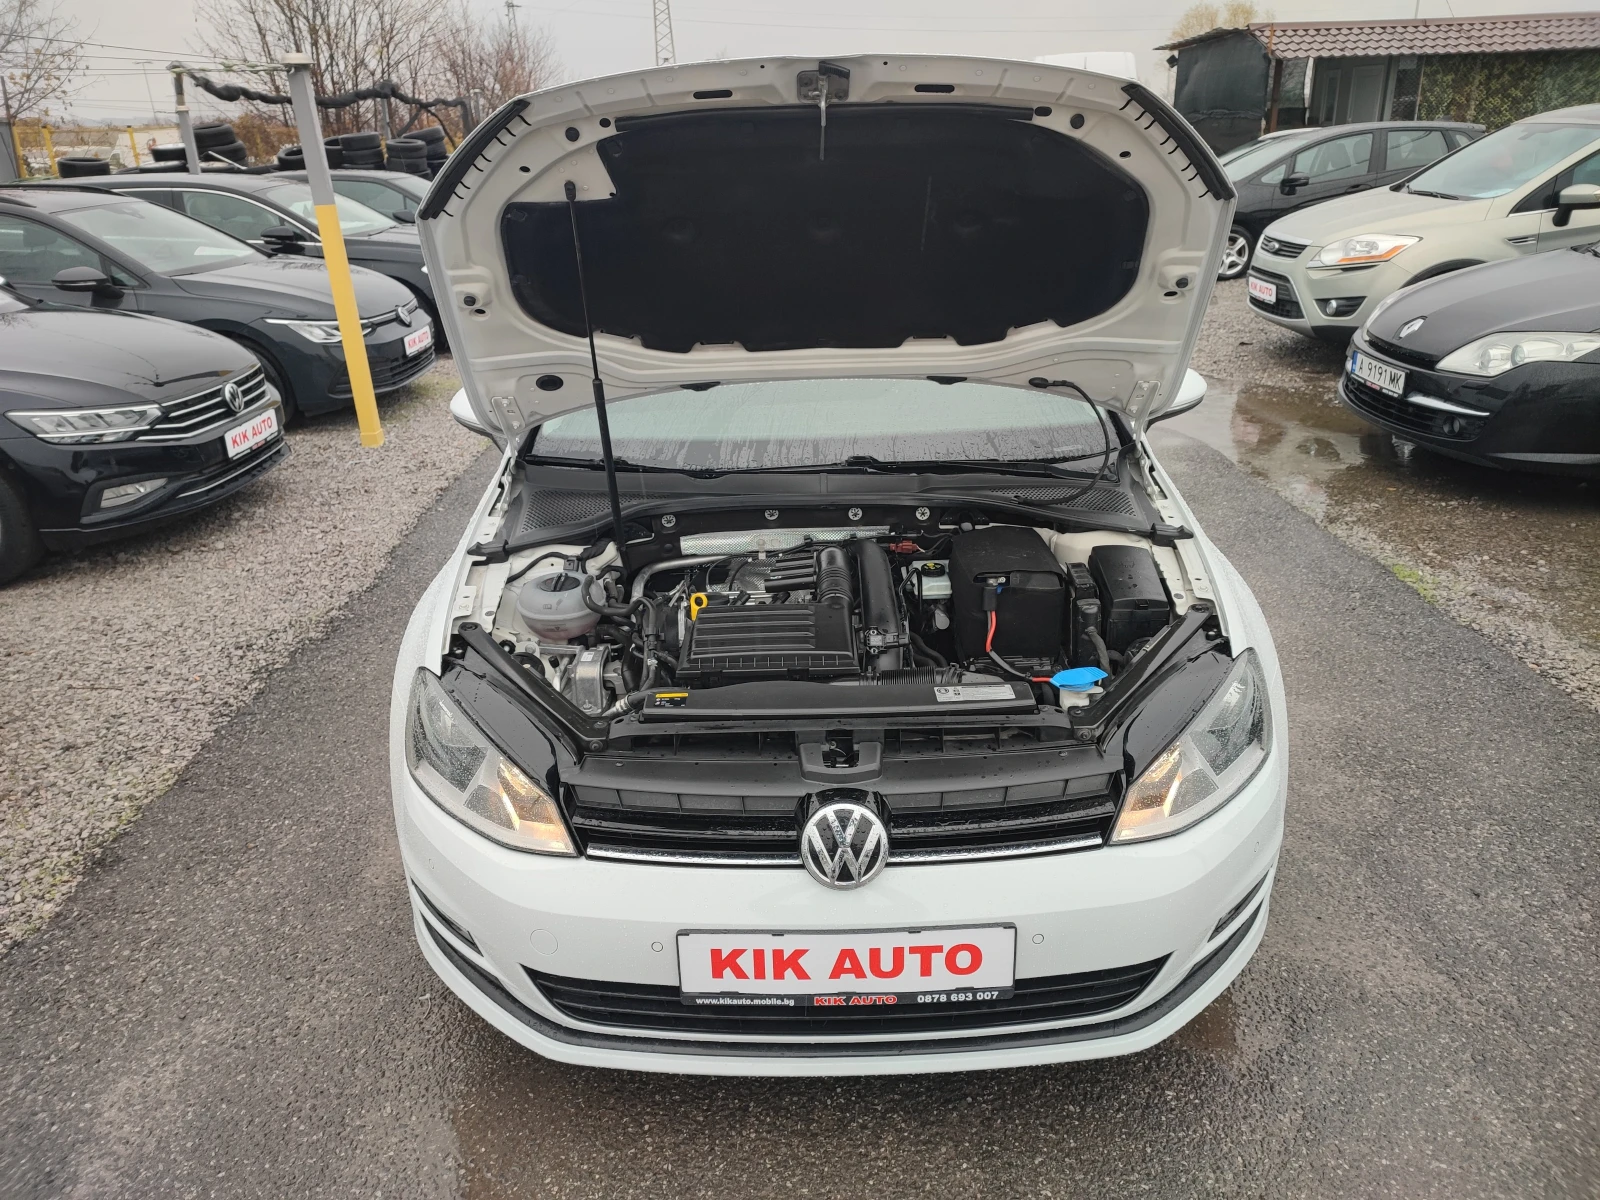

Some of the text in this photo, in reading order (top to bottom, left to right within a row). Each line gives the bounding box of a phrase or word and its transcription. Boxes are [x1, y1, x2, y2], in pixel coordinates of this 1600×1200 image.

[1359, 358, 1364, 374] A
[231, 429, 249, 449] KIK
[251, 416, 273, 440] AUTO
[710, 943, 983, 980] KIK AUTO
[695, 997, 795, 1007] www.kikauto.mobile.bg
[814, 995, 898, 1006] KIK AUTO
[917, 991, 999, 1003] 0878 693 007
